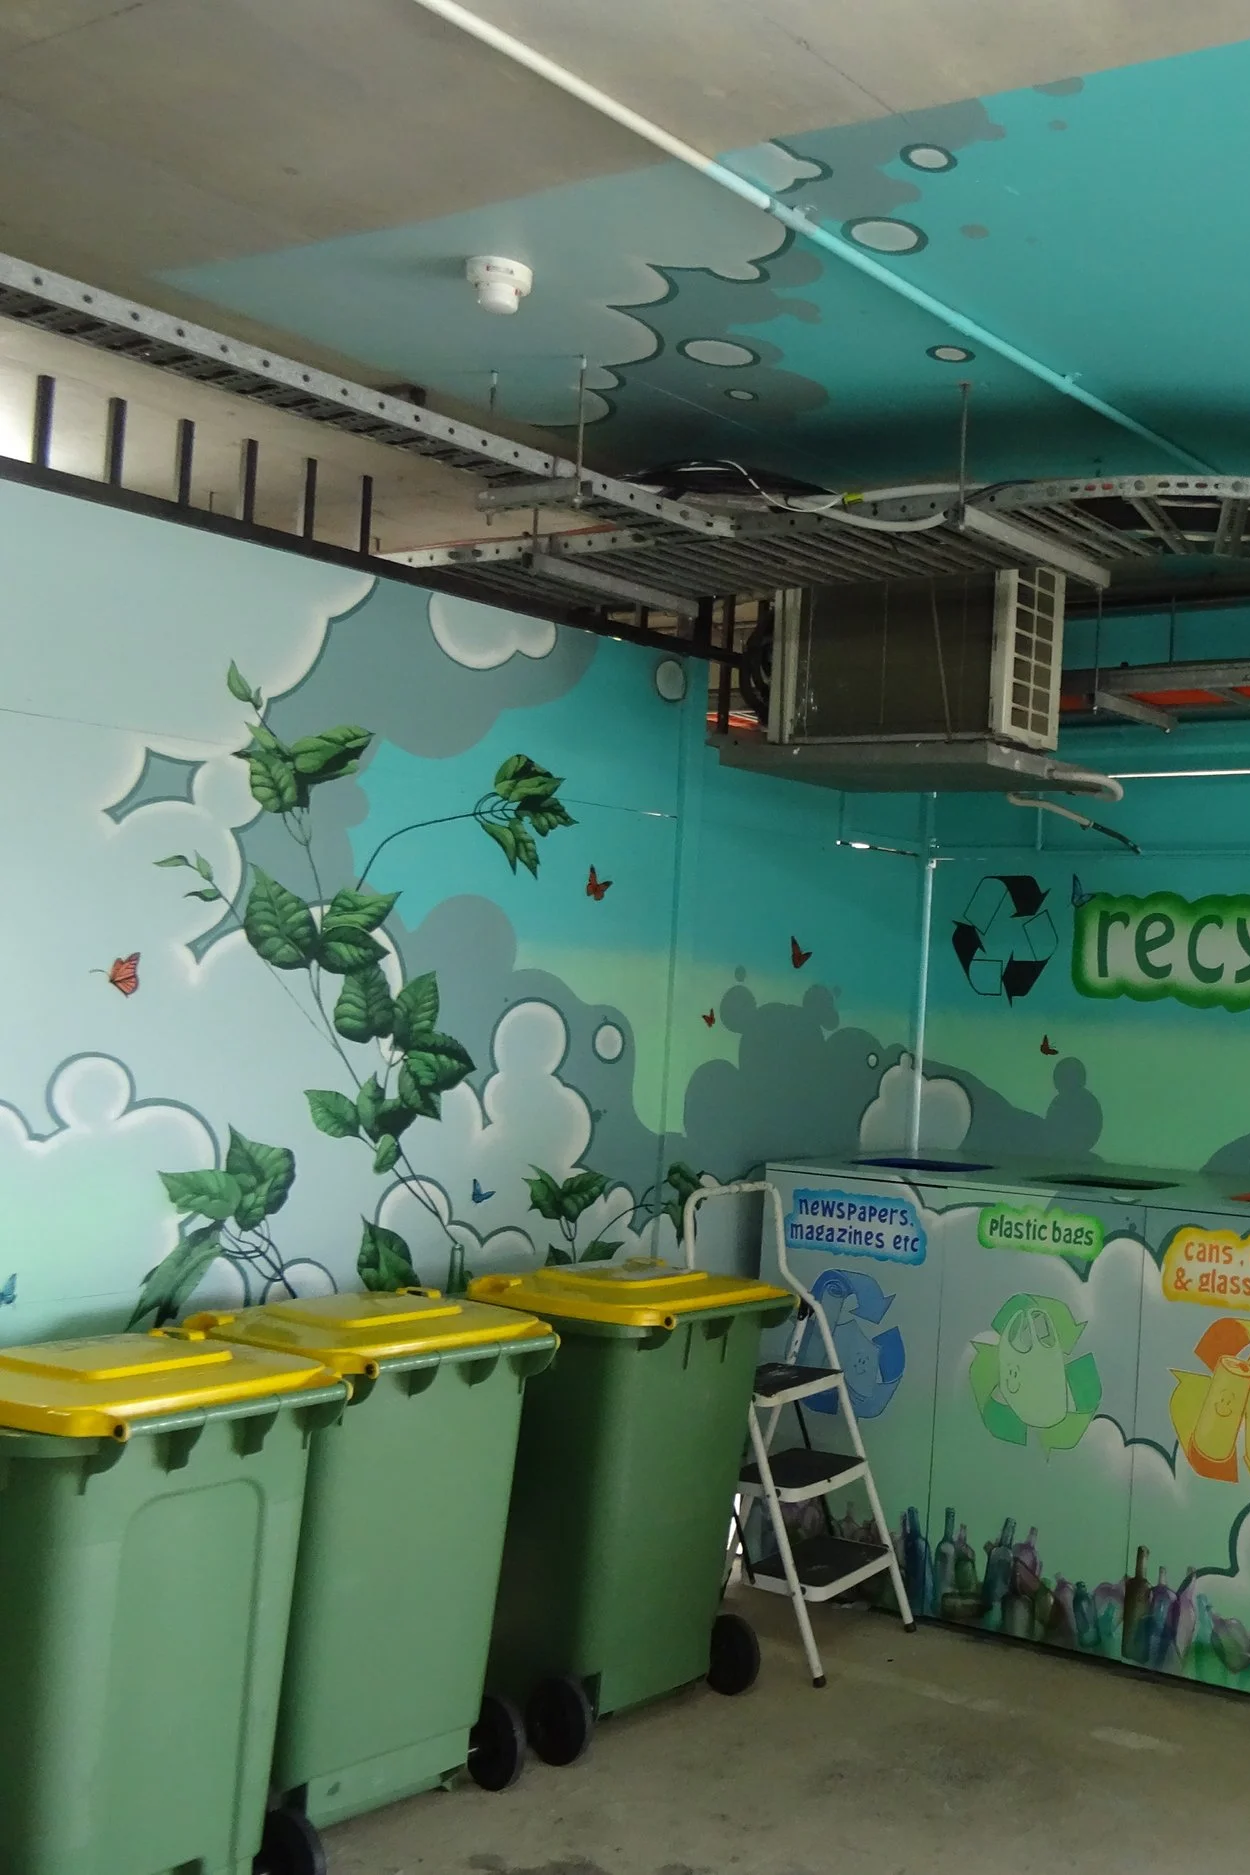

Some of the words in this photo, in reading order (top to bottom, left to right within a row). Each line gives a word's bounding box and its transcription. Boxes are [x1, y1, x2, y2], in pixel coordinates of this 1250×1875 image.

[790, 1222, 885, 1249] magazines
[893, 1234, 920, 1252] etc
[989, 1214, 1047, 1241] plastic
[1052, 1220, 1094, 1246] bags
[1174, 1266, 1193, 1291] &
